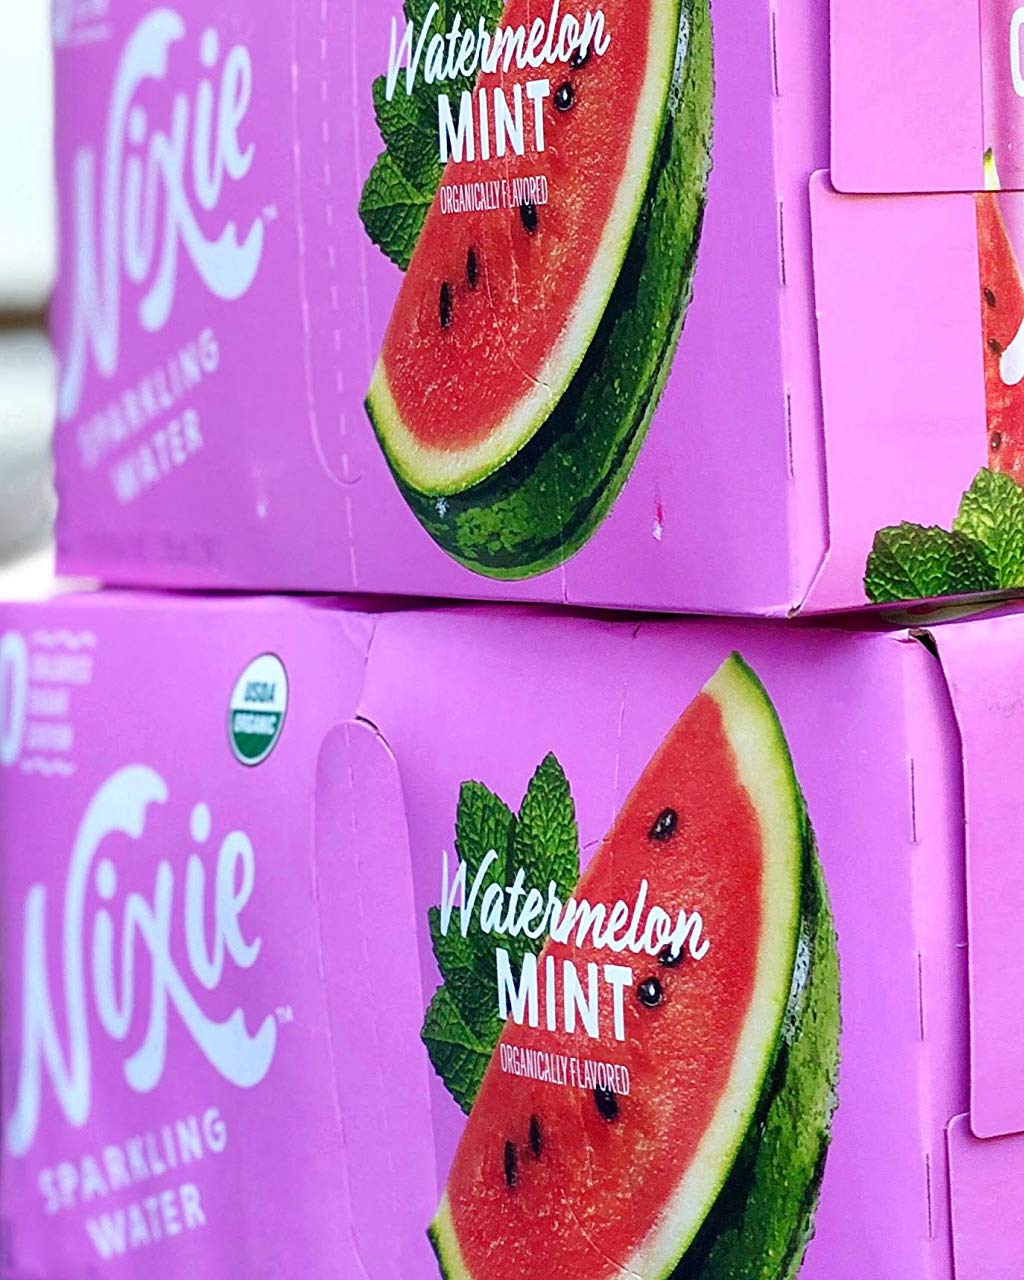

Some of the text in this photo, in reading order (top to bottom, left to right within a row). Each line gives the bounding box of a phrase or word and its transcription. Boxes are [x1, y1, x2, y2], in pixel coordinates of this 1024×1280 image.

[437, 78, 550, 164] MINT
[57, 6, 264, 421] Nixie
[440, 175, 548, 215] ORGANICALLY FLAVORED
[440, 848, 711, 960] Watermelon
[7, 763, 277, 1158] Nixie
[494, 947, 634, 1042] MINT
[500, 1042, 630, 1097] ORGANICALLY FLAVORED
[37, 1107, 228, 1216] SPARKLING
[85, 1182, 207, 1261] WATER
